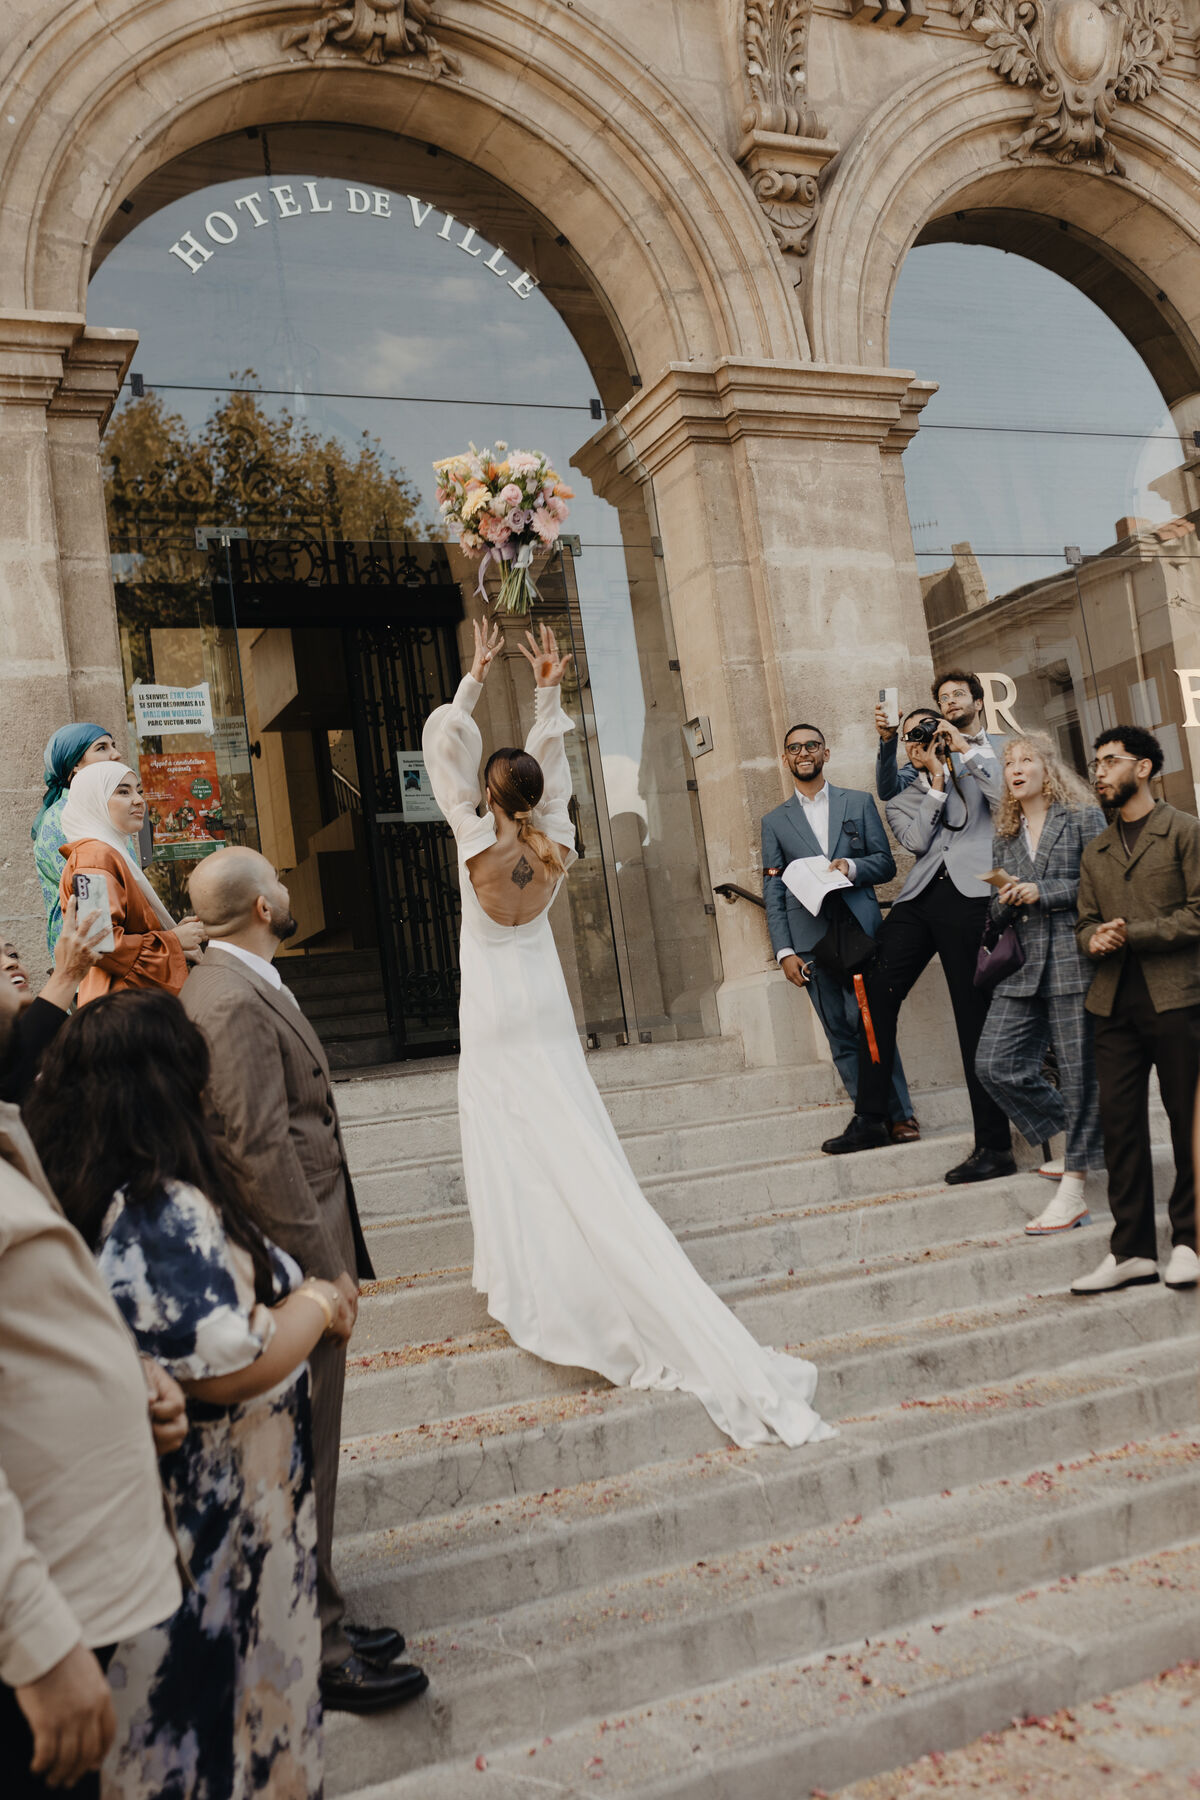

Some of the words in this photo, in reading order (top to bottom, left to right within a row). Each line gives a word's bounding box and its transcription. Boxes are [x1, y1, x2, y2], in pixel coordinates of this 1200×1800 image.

[168, 182, 333, 274] HOTEL
[346, 188, 392, 218] DE
[407, 194, 541, 300] VILLE
[975, 672, 1025, 735] R
